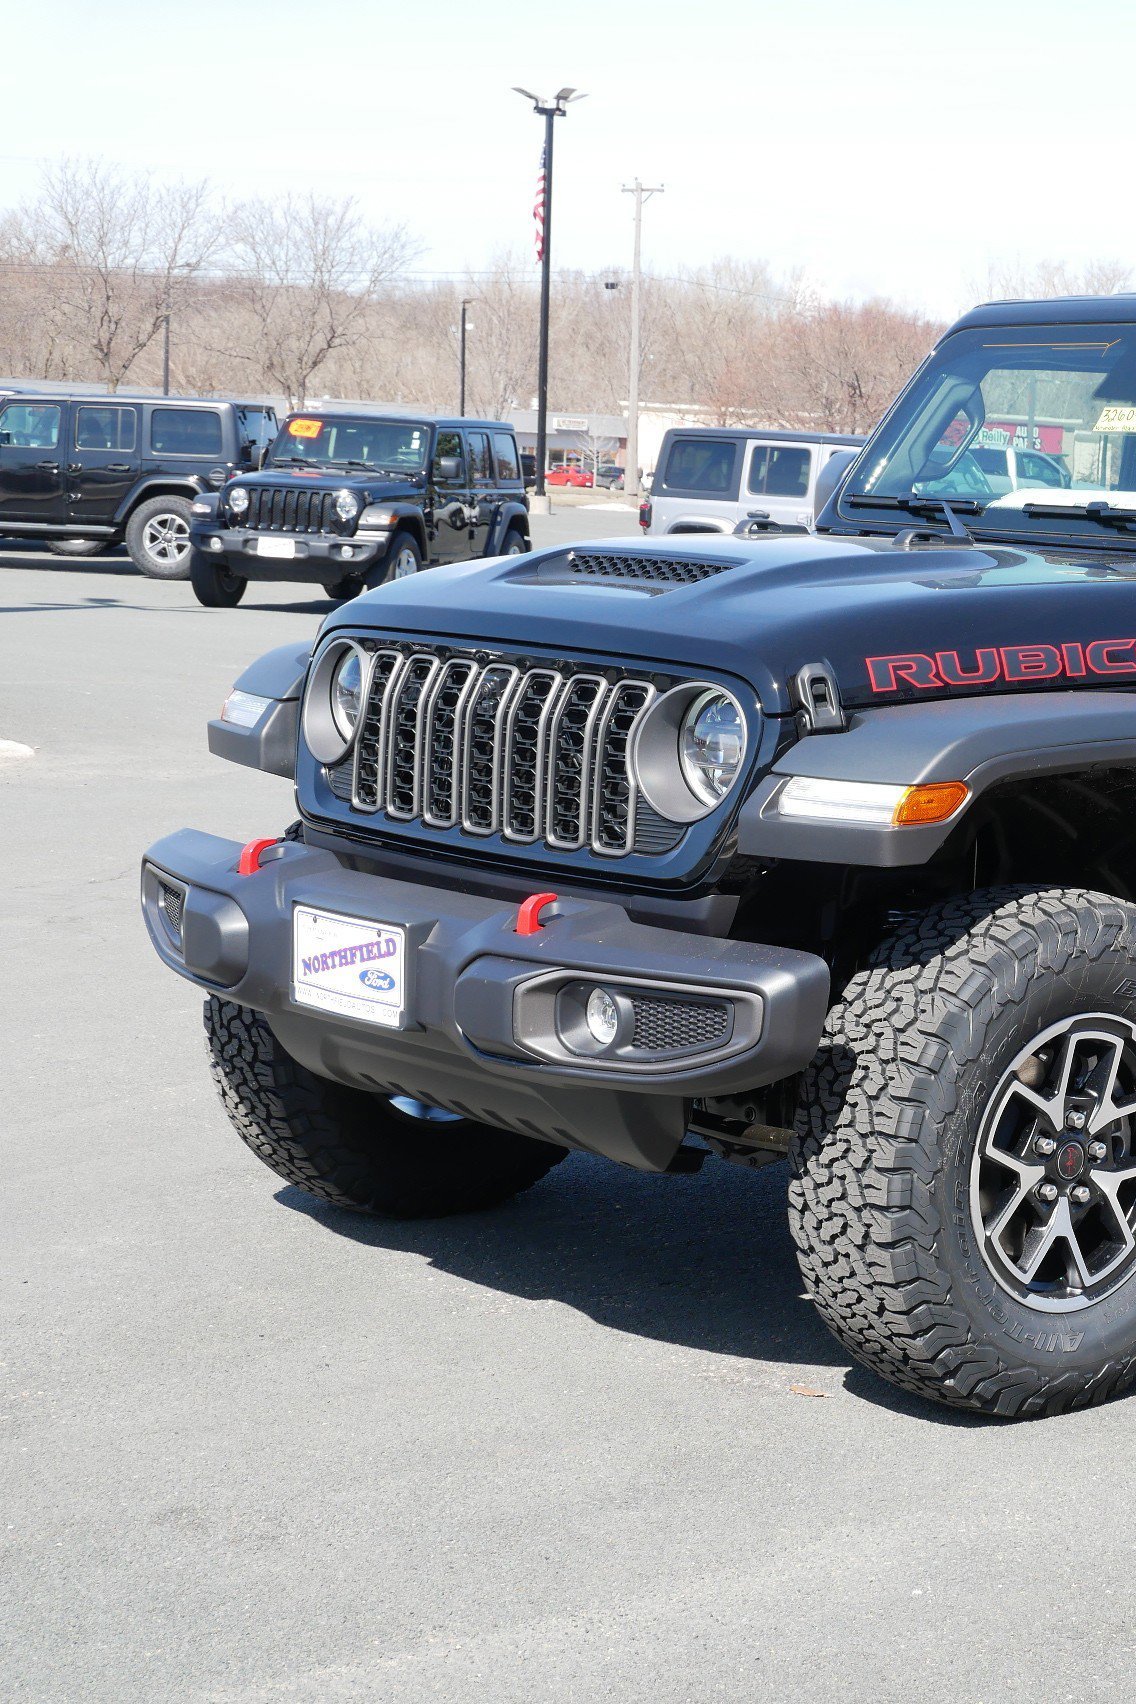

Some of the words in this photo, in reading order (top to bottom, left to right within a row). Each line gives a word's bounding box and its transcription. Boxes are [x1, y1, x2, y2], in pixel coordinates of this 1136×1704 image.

[1015, 425, 1039, 438] AUO
[1012, 436, 1042, 449] PARS
[301, 938, 397, 977] NORTHFIELD
[364, 971, 391, 990] Ford
